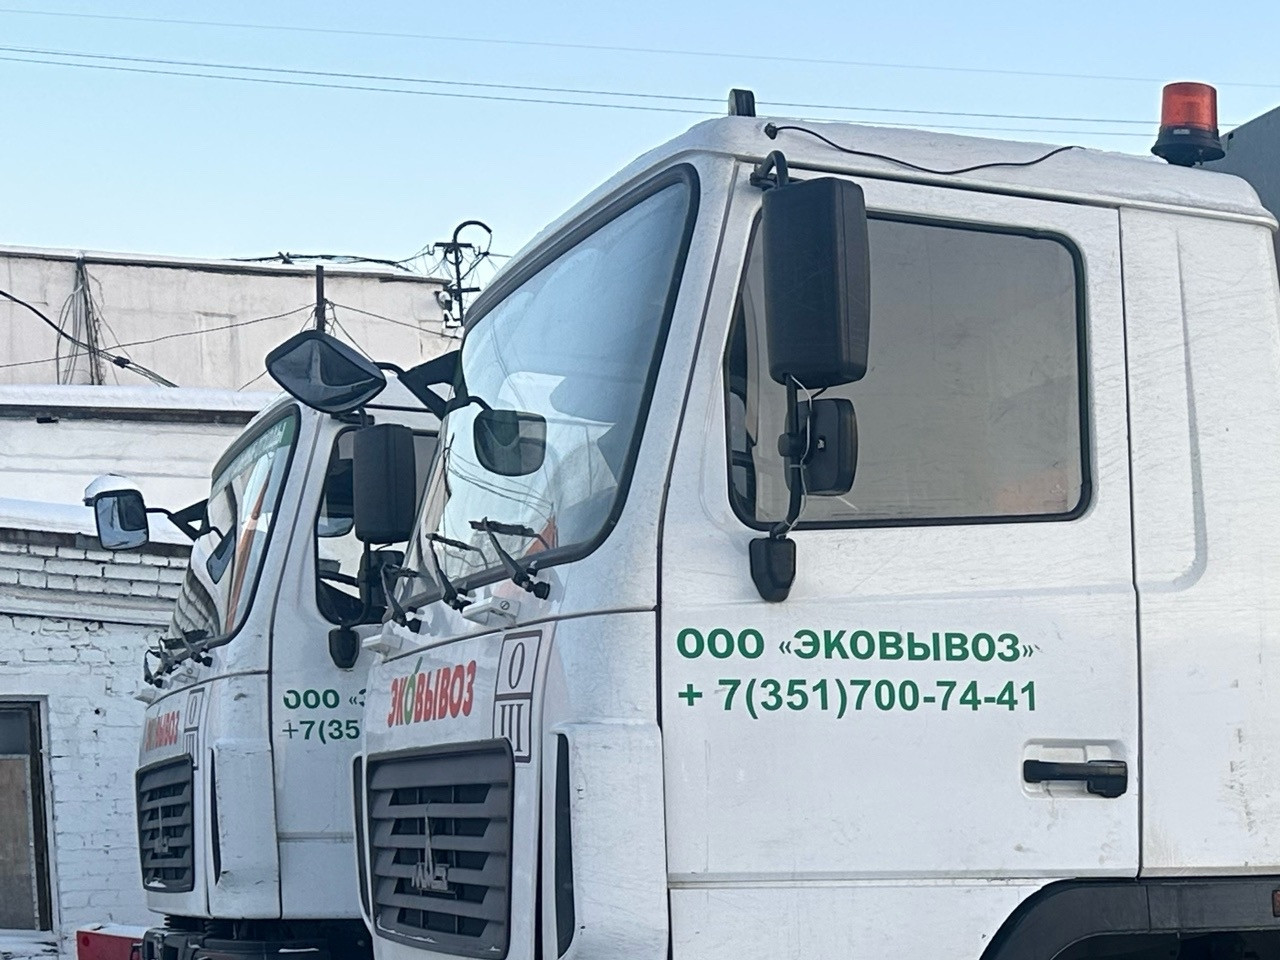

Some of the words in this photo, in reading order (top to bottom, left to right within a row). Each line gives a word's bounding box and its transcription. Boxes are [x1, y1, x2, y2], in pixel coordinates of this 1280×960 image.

[677, 628, 765, 660] ООО
[778, 628, 1034, 662] «ЭКОВЫВОЗ»
[283, 689, 340, 709] ООО
[387, 657, 477, 728] ЭКОВЫВОЗ
